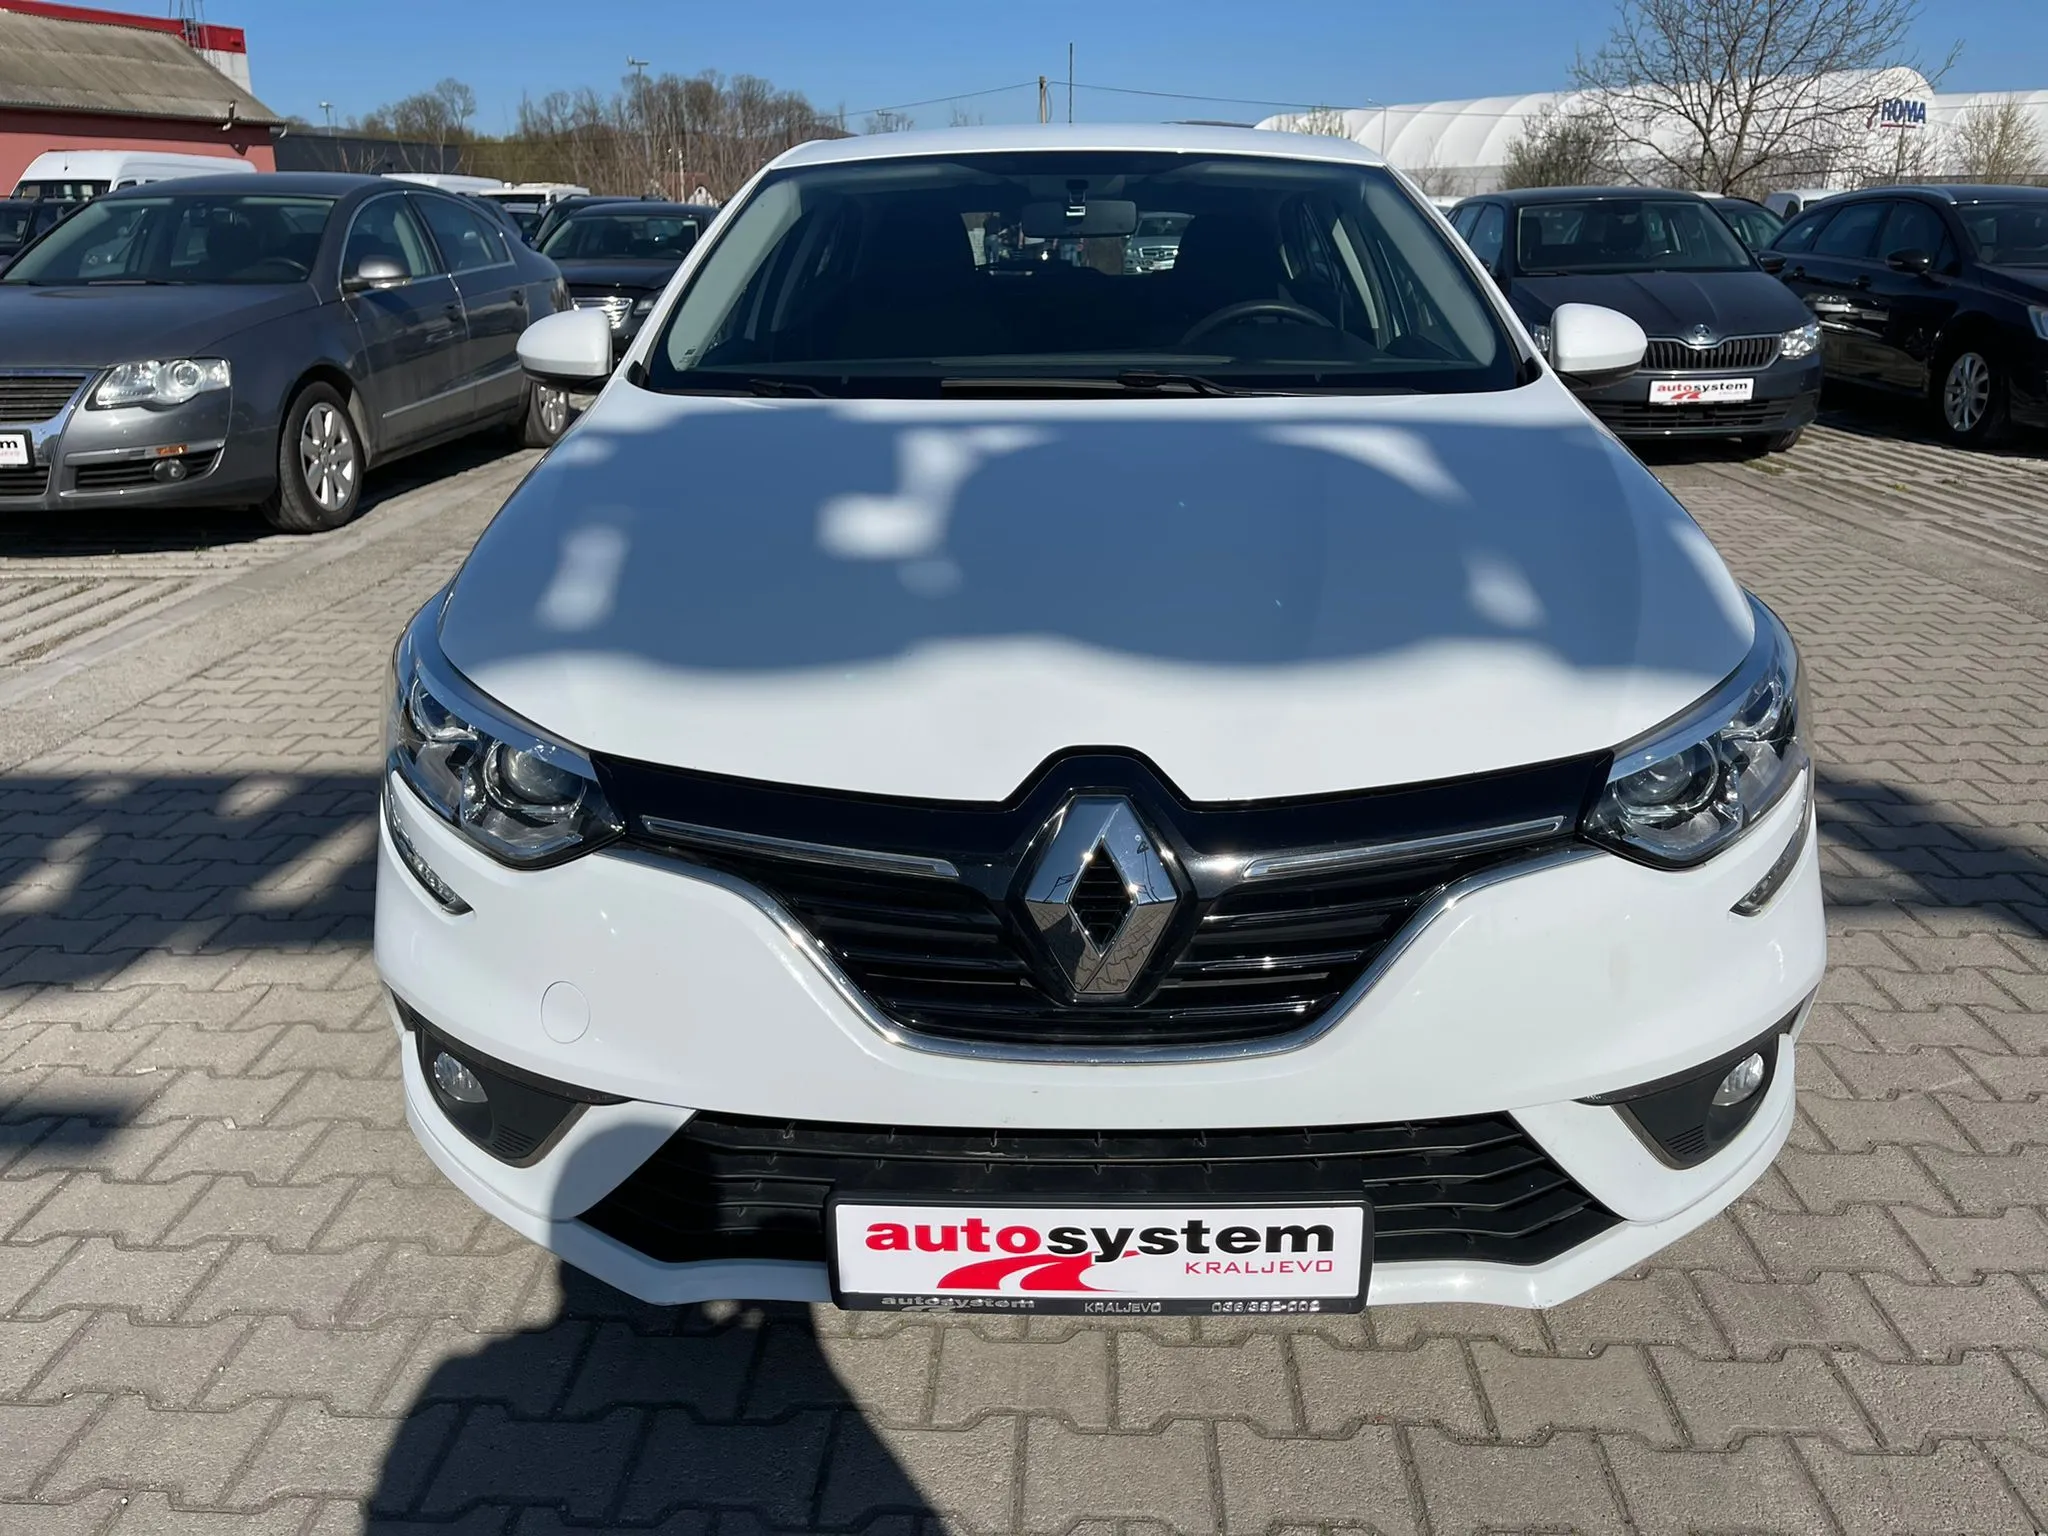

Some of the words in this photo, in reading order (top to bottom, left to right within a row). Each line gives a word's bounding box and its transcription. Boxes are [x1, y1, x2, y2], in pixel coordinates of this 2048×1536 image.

[1880, 98, 1927, 124] ROMA
[1656, 382, 1748, 393] autosystem
[864, 1218, 1335, 1263] autosystem
[1185, 1260, 1334, 1275] KRALJEVO
[881, 1296, 1035, 1309] autosystem
[1083, 1301, 1162, 1314] KRALJEVO
